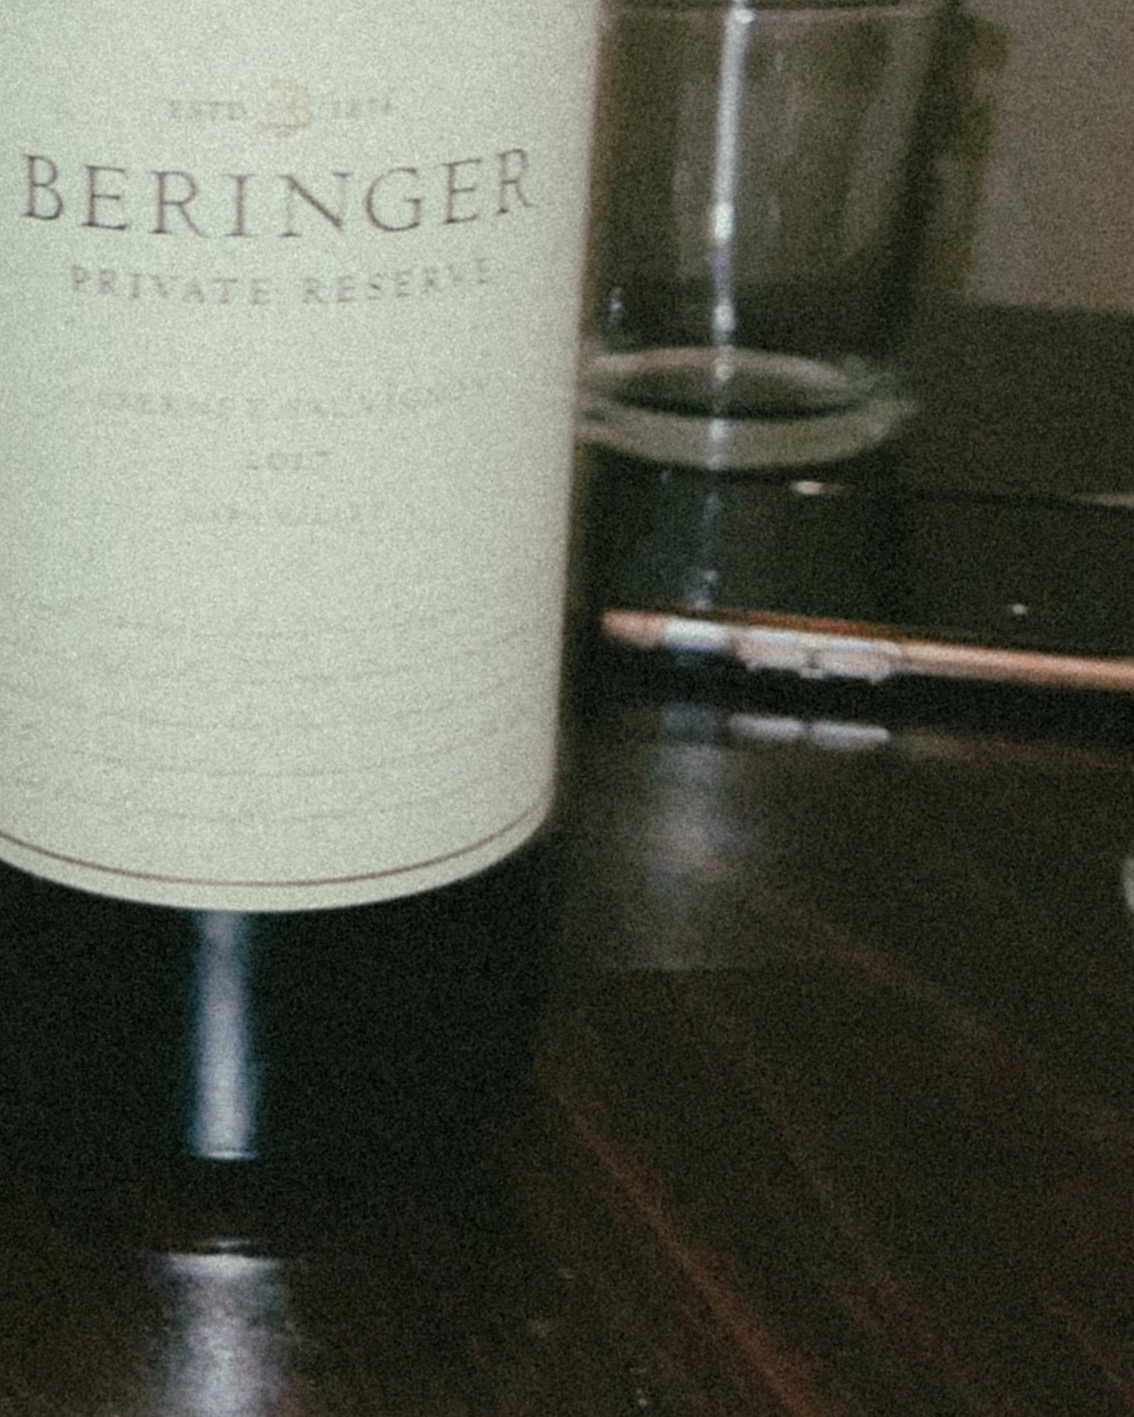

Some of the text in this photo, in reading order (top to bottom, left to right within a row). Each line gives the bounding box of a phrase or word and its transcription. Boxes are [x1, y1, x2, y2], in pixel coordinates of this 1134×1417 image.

[21, 147, 537, 239] BERINGER
[69, 255, 493, 306] PRIVATE RESERVE
